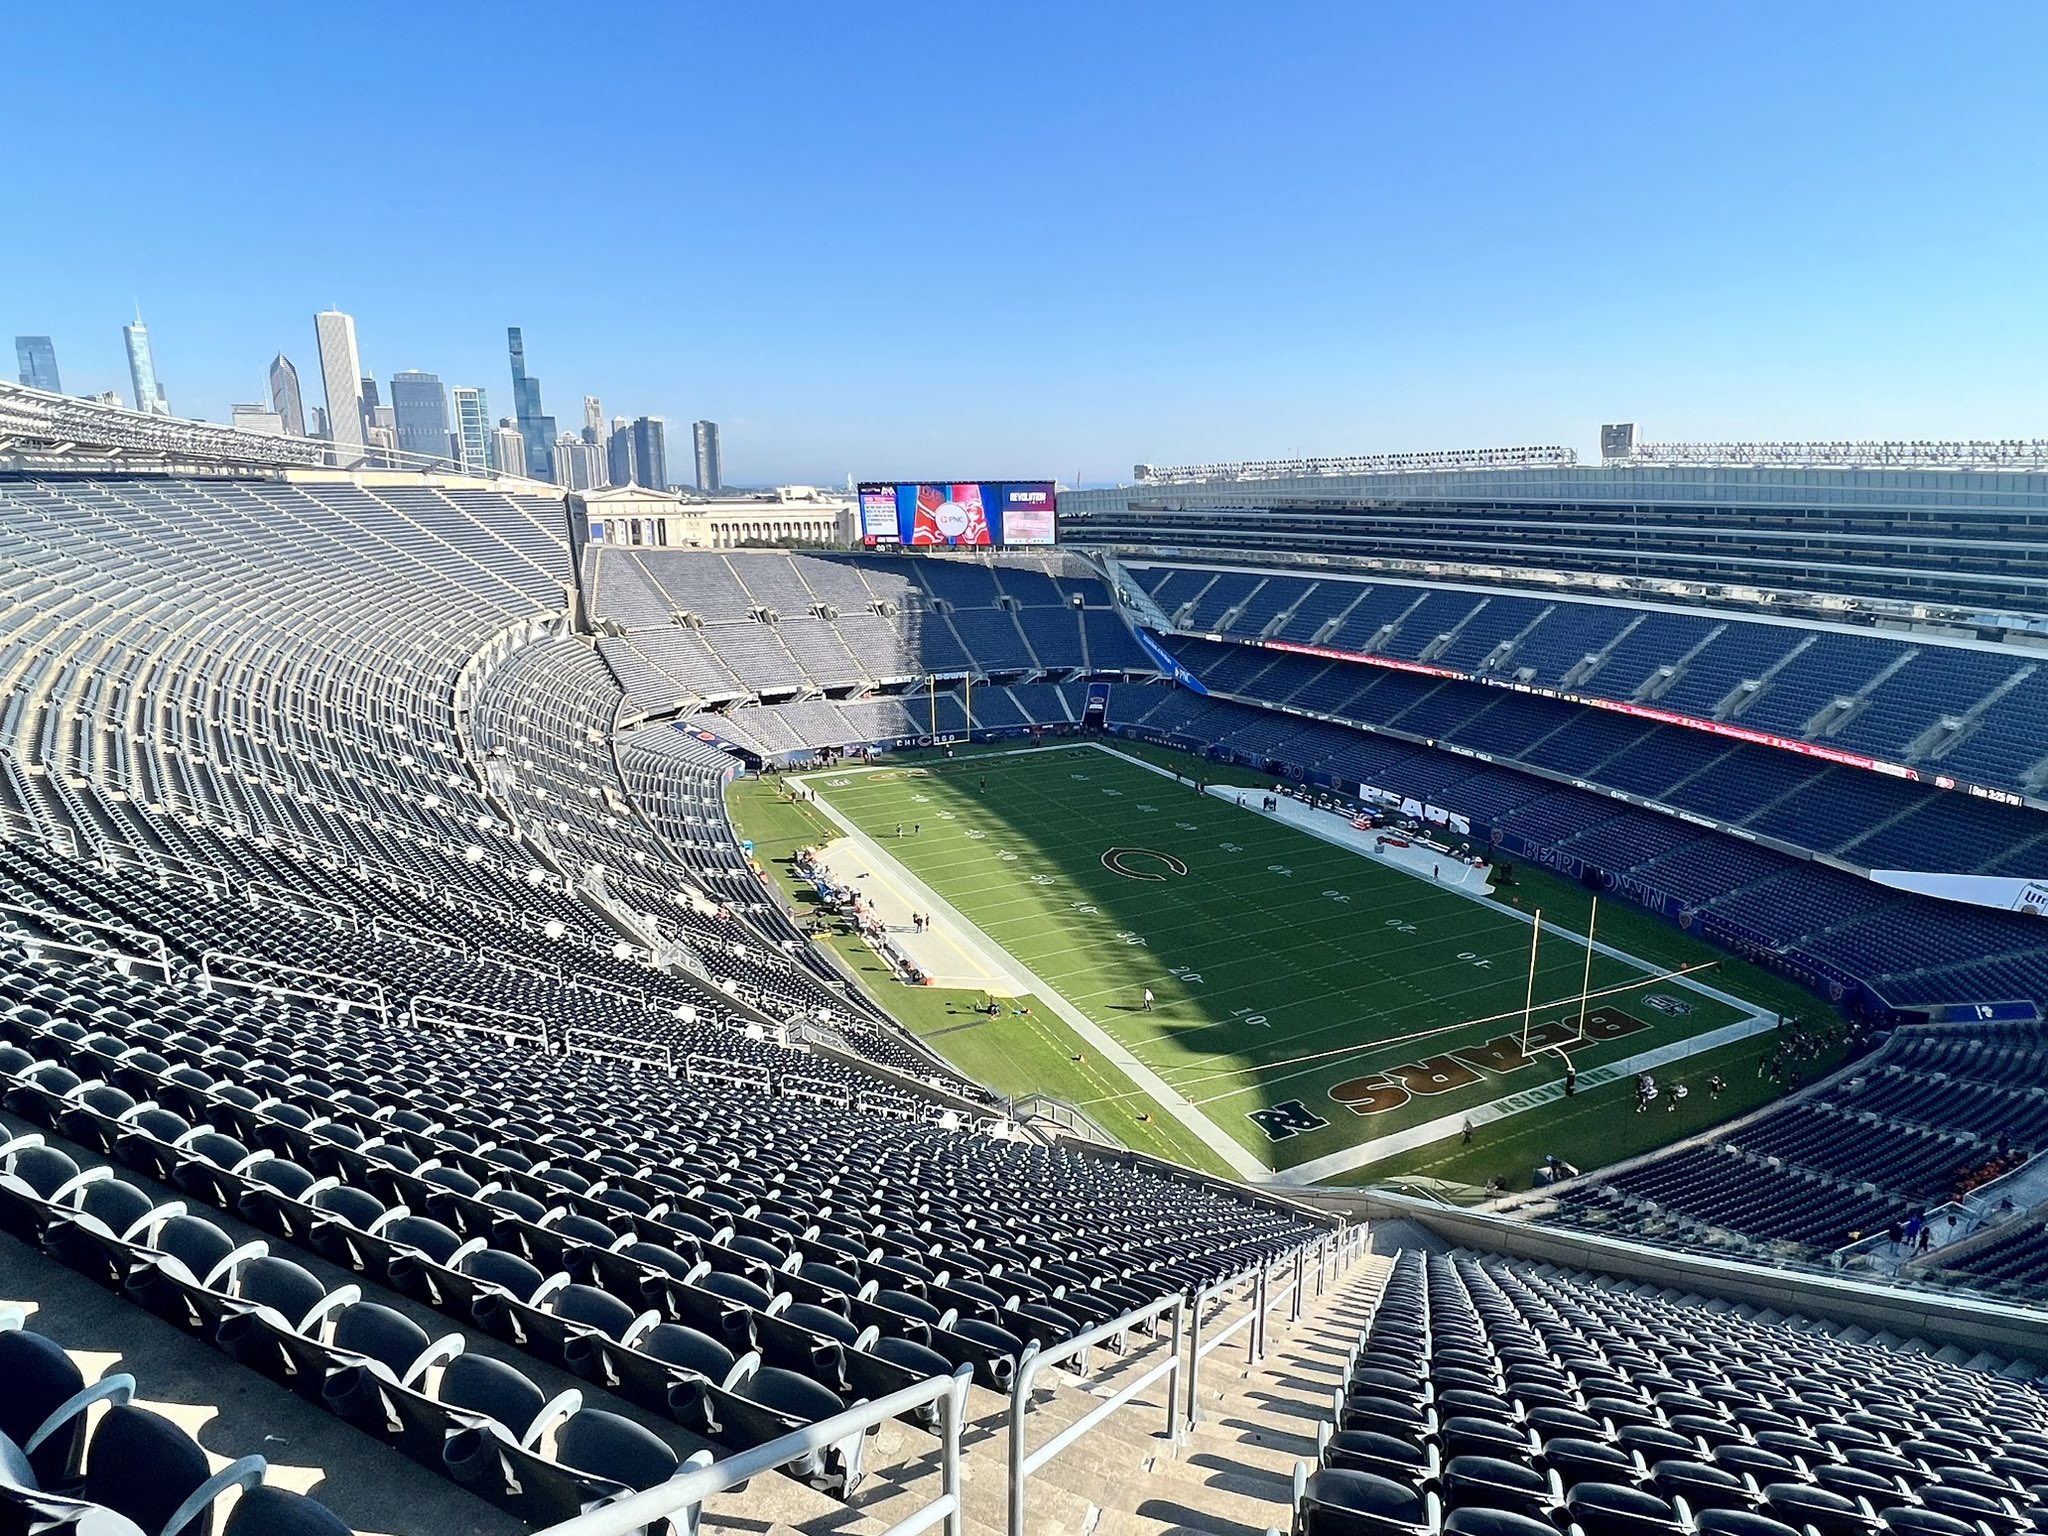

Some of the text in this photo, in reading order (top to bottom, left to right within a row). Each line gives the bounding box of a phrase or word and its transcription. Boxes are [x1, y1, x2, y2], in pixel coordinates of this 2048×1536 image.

[1360, 783, 1470, 835] BEARS
[1116, 930, 1143, 946] 30
[1168, 965, 1200, 984] 20
[1230, 1006, 1267, 1026] 10
[1327, 1005, 1655, 1117] BEARS
[1577, 1067, 1620, 1086] END
